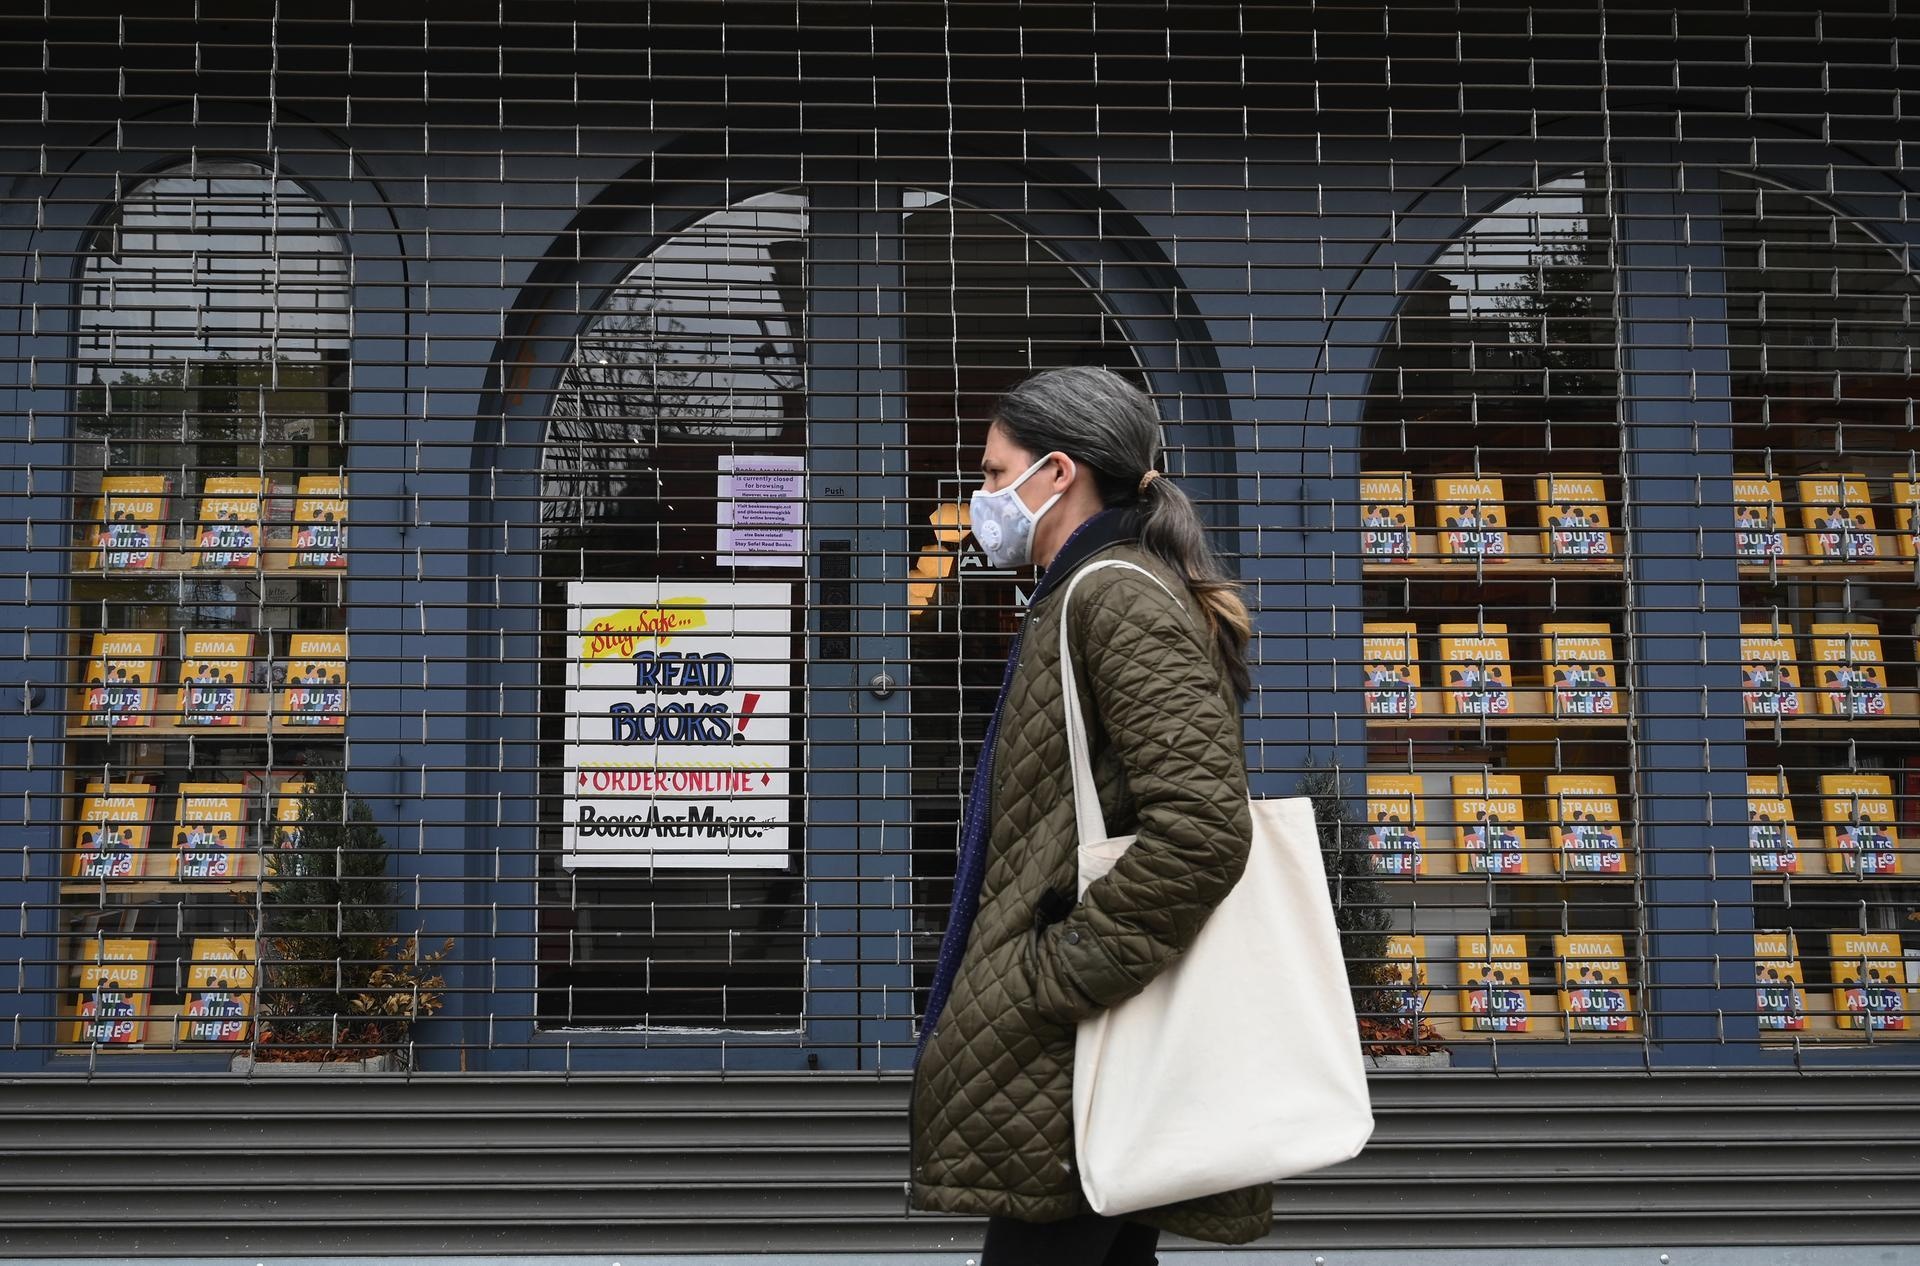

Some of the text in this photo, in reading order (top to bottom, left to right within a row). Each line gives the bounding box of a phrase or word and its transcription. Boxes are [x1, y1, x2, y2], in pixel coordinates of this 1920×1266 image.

[743, 475, 771, 483] currently
[824, 487, 844, 495] Push
[1360, 483, 1401, 494] EMMA
[1449, 484, 1492, 495] EMMA
[1552, 484, 1593, 494] EMMA
[1734, 485, 1770, 495] MMA
[110, 502, 153, 513] TRAUB
[207, 502, 257, 513] STRAUB
[302, 501, 348, 512] STRAU
[1370, 517, 1395, 527] ALL
[1565, 517, 1589, 527] ALL
[1741, 519, 1765, 528] ALL
[1831, 518, 1855, 528] ALL
[98, 537, 149, 548] ADULTS
[200, 536, 252, 548] ADULTS
[1449, 532, 1502, 543] ADULTS
[1553, 532, 1604, 542] ADULTS
[1738, 534, 1782, 545] DULTS
[206, 552, 240, 562] HERE
[303, 552, 337, 562] HERE
[591, 622, 633, 658] Stay
[1363, 638, 1406, 646] EMMA
[1455, 638, 1497, 646] EMMA
[1557, 638, 1600, 646] EMMA
[102, 643, 142, 654] EMMA
[194, 642, 235, 653] EMMA
[301, 642, 341, 653] EMMA
[1450, 650, 1503, 660] STRAUB
[632, 650, 733, 696] READ
[1374, 671, 1399, 681] ALL
[1569, 671, 1595, 681] ALL
[1841, 671, 1866, 682] ALL
[89, 693, 141, 705] ADULTS
[290, 693, 341, 705] ADULTS
[1370, 702, 1406, 713] HERE
[1463, 702, 1499, 713] HERE
[1567, 702, 1603, 713] HERE
[1753, 702, 1788, 713] HERE
[94, 798, 135, 807] EMMA
[187, 798, 228, 807] EMMA
[1462, 802, 1516, 814] STRAUB
[1561, 802, 1613, 813] STRAUB
[1834, 803, 1888, 814] STAUB
[87, 811, 138, 821] STRAUB
[1380, 826, 1405, 836] ALL
[1576, 826, 1601, 834] ALL
[1751, 826, 1776, 834] ALL
[1851, 826, 1877, 835] ALL
[192, 833, 215, 844] ALL
[1475, 856, 1511, 868] HERE
[1574, 855, 1610, 867] HERE
[1751, 855, 1787, 866] HERE
[85, 865, 119, 876] HERE
[1569, 943, 1613, 954] EMMA
[1845, 941, 1889, 953] EMMA
[86, 969, 138, 980] STRAUB
[195, 968, 247, 980] STRAUB
[205, 993, 229, 1001] ALL
[1847, 995, 1901, 1007] ADULTS
[1571, 997, 1624, 1009] ADULTS
[1481, 1017, 1517, 1026] HERE
[1581, 1016, 1618, 1026] HERE
[87, 1025, 121, 1037] HERE
[195, 1023, 229, 1036] HERE
